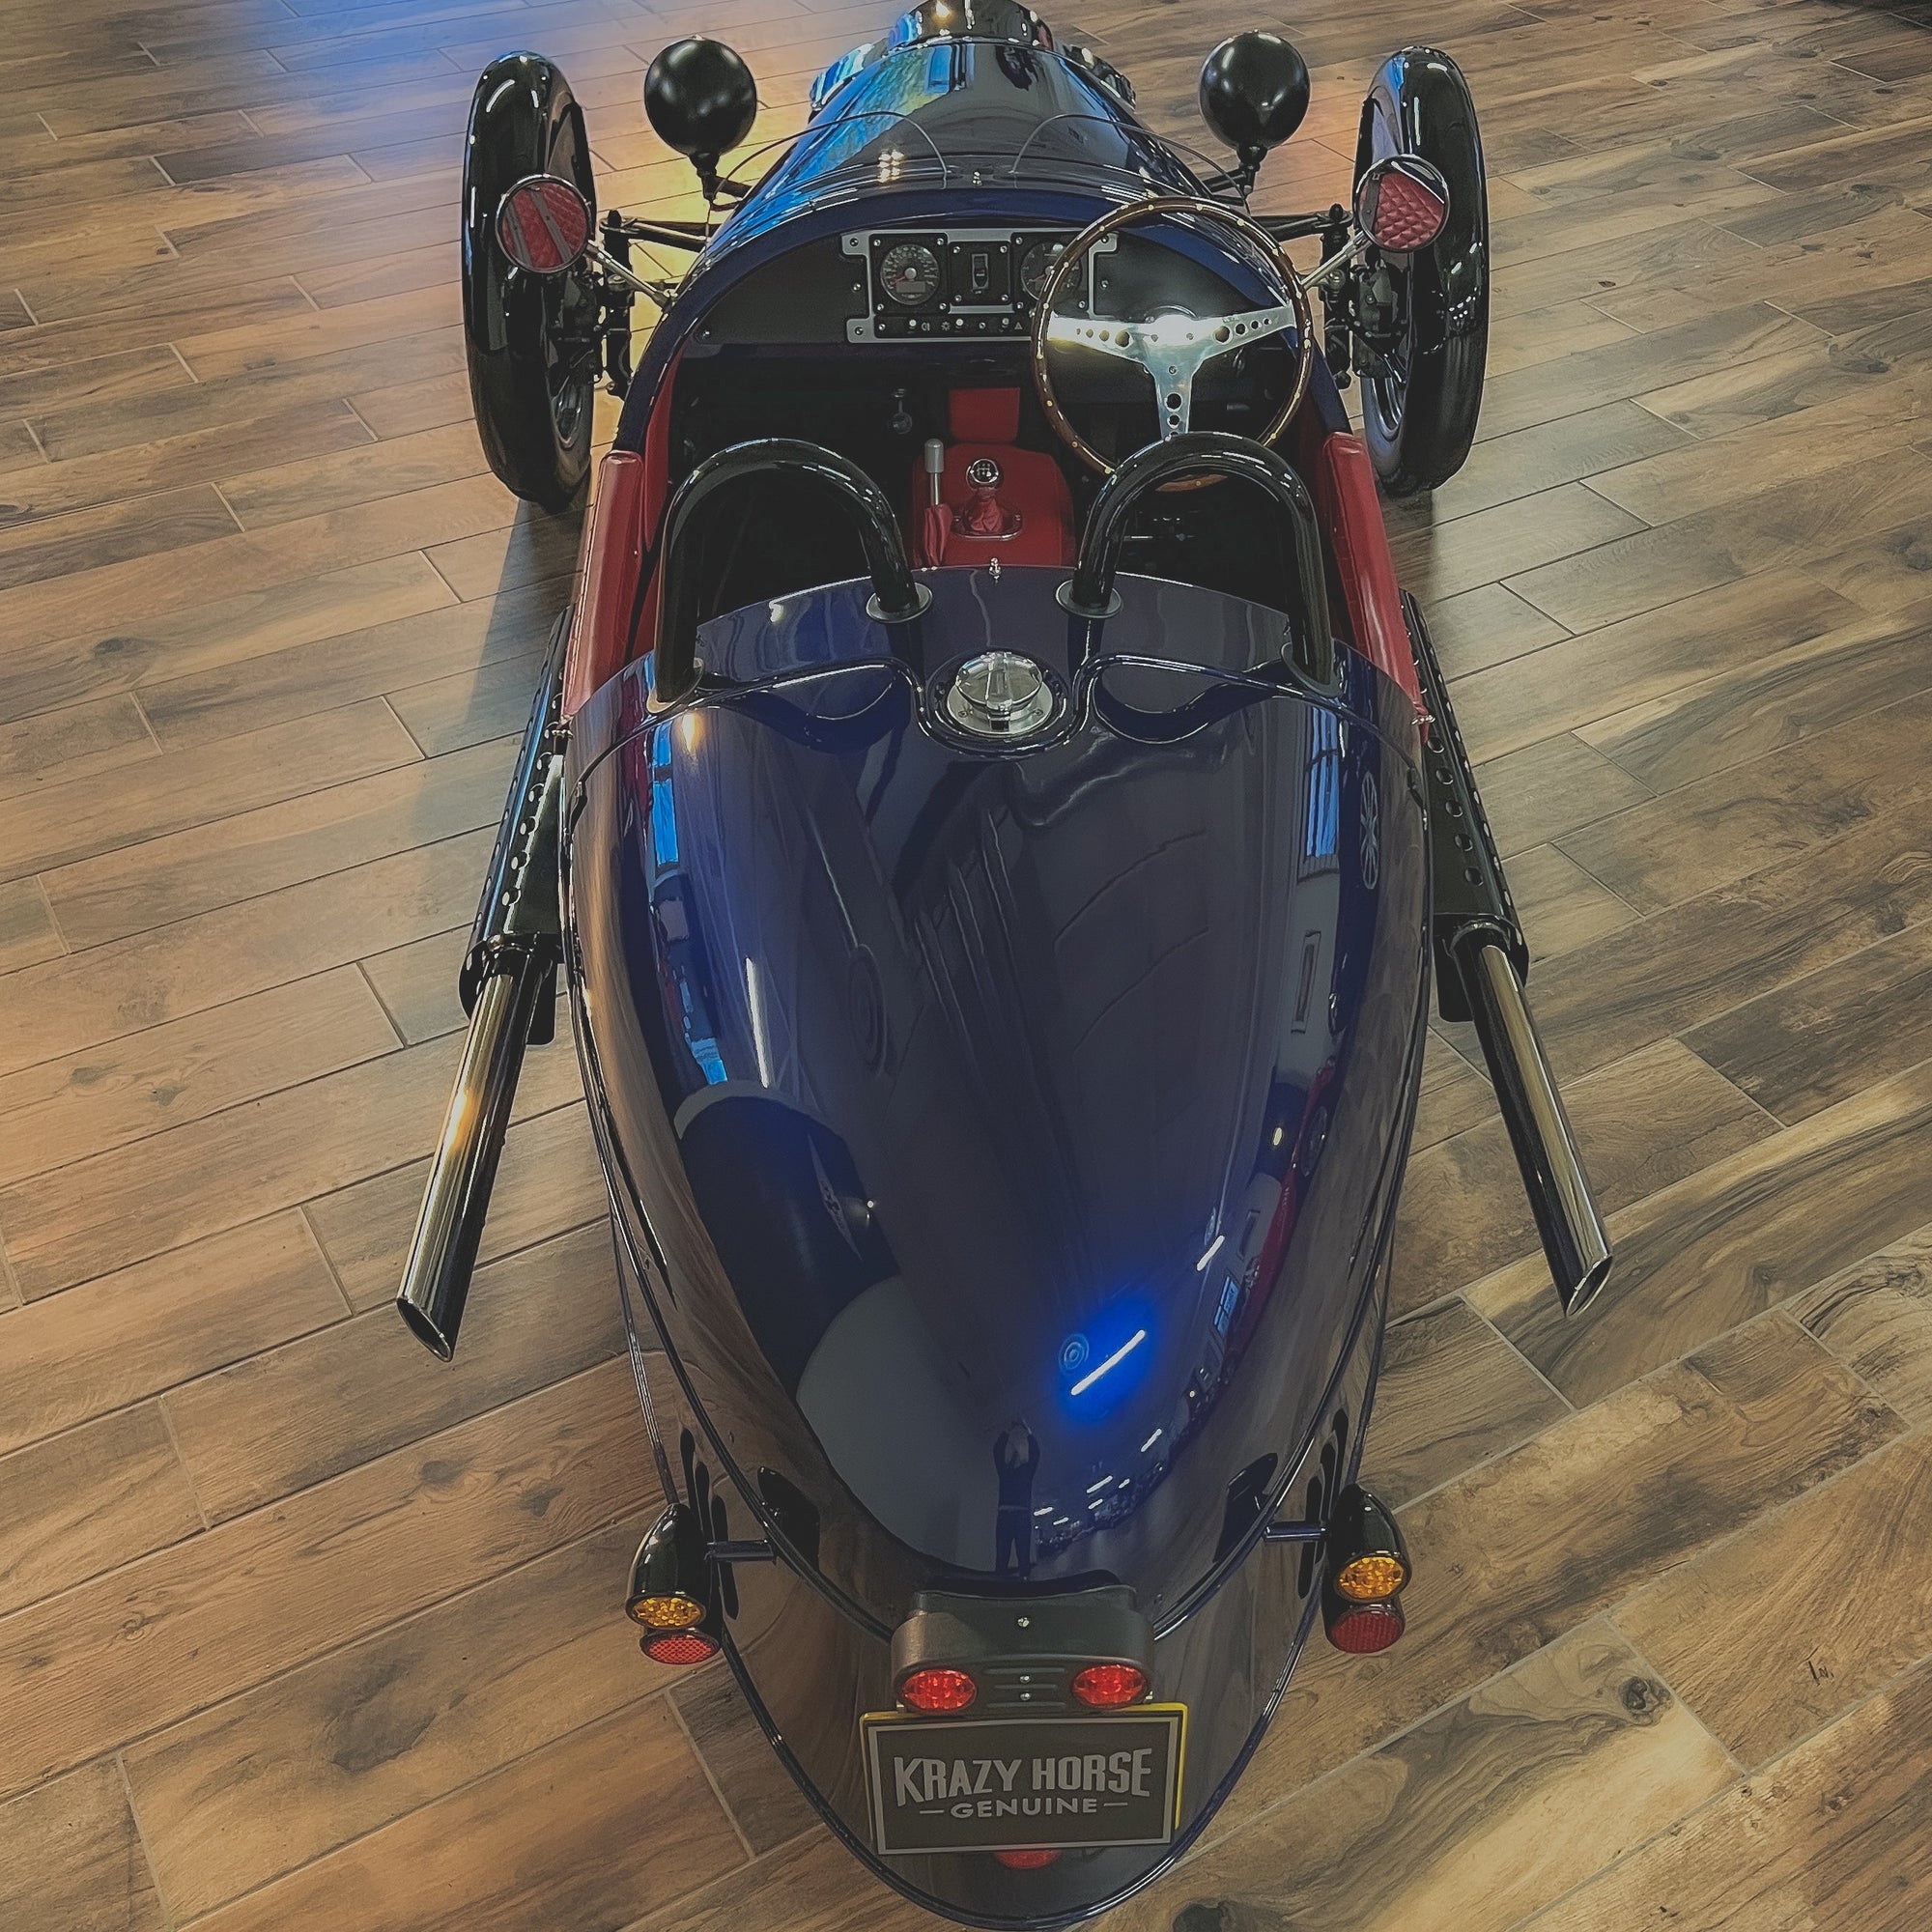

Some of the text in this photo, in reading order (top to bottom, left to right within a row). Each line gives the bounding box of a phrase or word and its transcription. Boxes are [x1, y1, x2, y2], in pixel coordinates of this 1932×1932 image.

[894, 1747, 1152, 1806] KRAZY HORSE
[950, 1797, 1097, 1818] GENUINE
